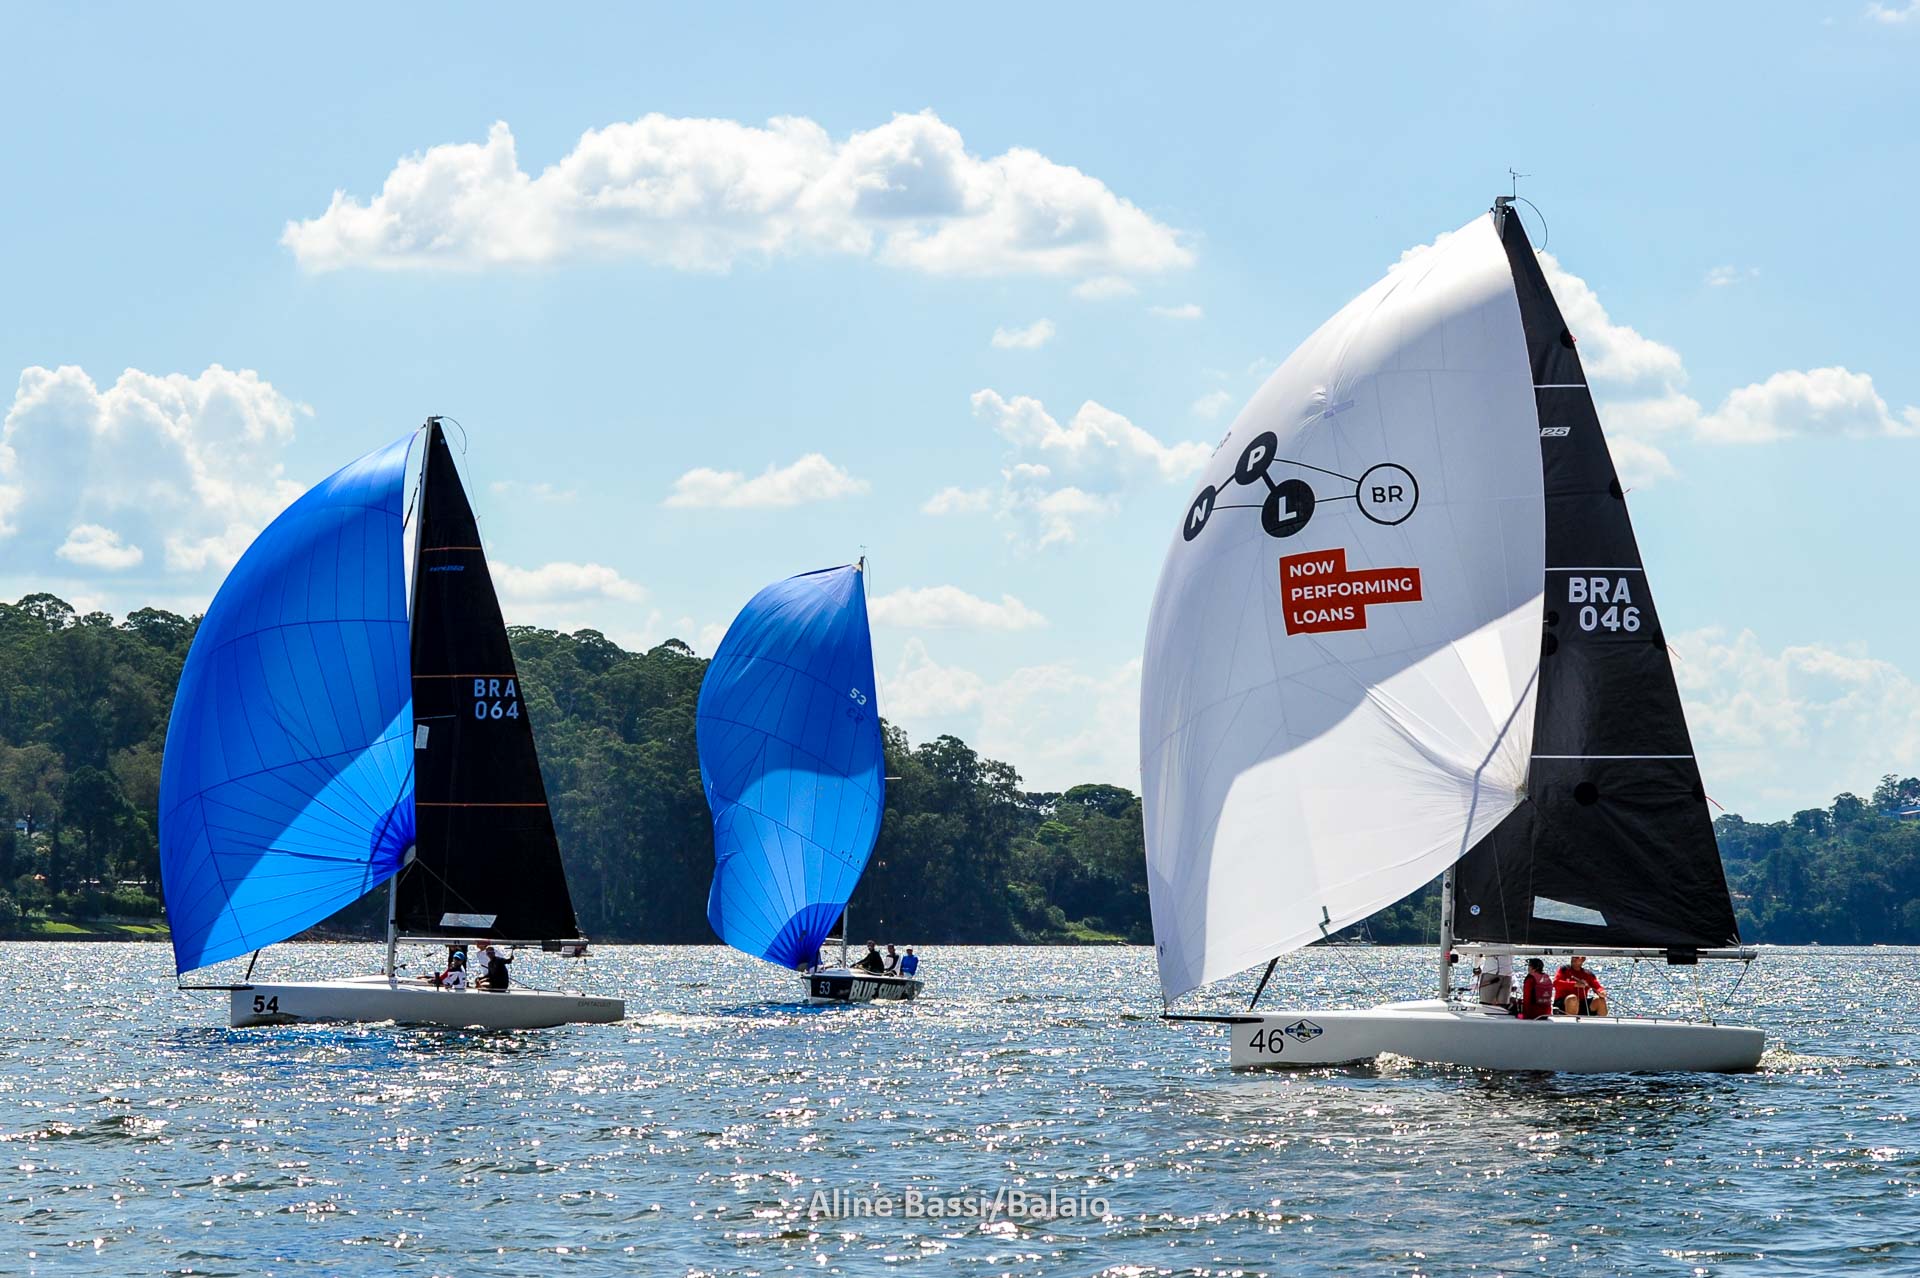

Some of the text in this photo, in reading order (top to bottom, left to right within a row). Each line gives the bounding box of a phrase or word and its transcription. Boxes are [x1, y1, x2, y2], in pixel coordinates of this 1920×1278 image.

[1246, 445, 1266, 472] P
[1371, 485, 1404, 503] BR
[1190, 504, 1208, 529] N
[1278, 496, 1297, 522] L
[1289, 560, 1335, 577] NOW
[1291, 577, 1413, 601] PERFORMING
[1568, 577, 1632, 604] BRA
[1293, 606, 1355, 625] LOANS
[1579, 605, 1641, 632] 046
[474, 678, 516, 697] BRA
[849, 687, 867, 706] 53
[475, 700, 519, 719] 064
[819, 981, 831, 995] 53
[848, 980, 879, 1000] BLUE
[253, 995, 279, 1013] 54
[1249, 1028, 1284, 1054] 46
